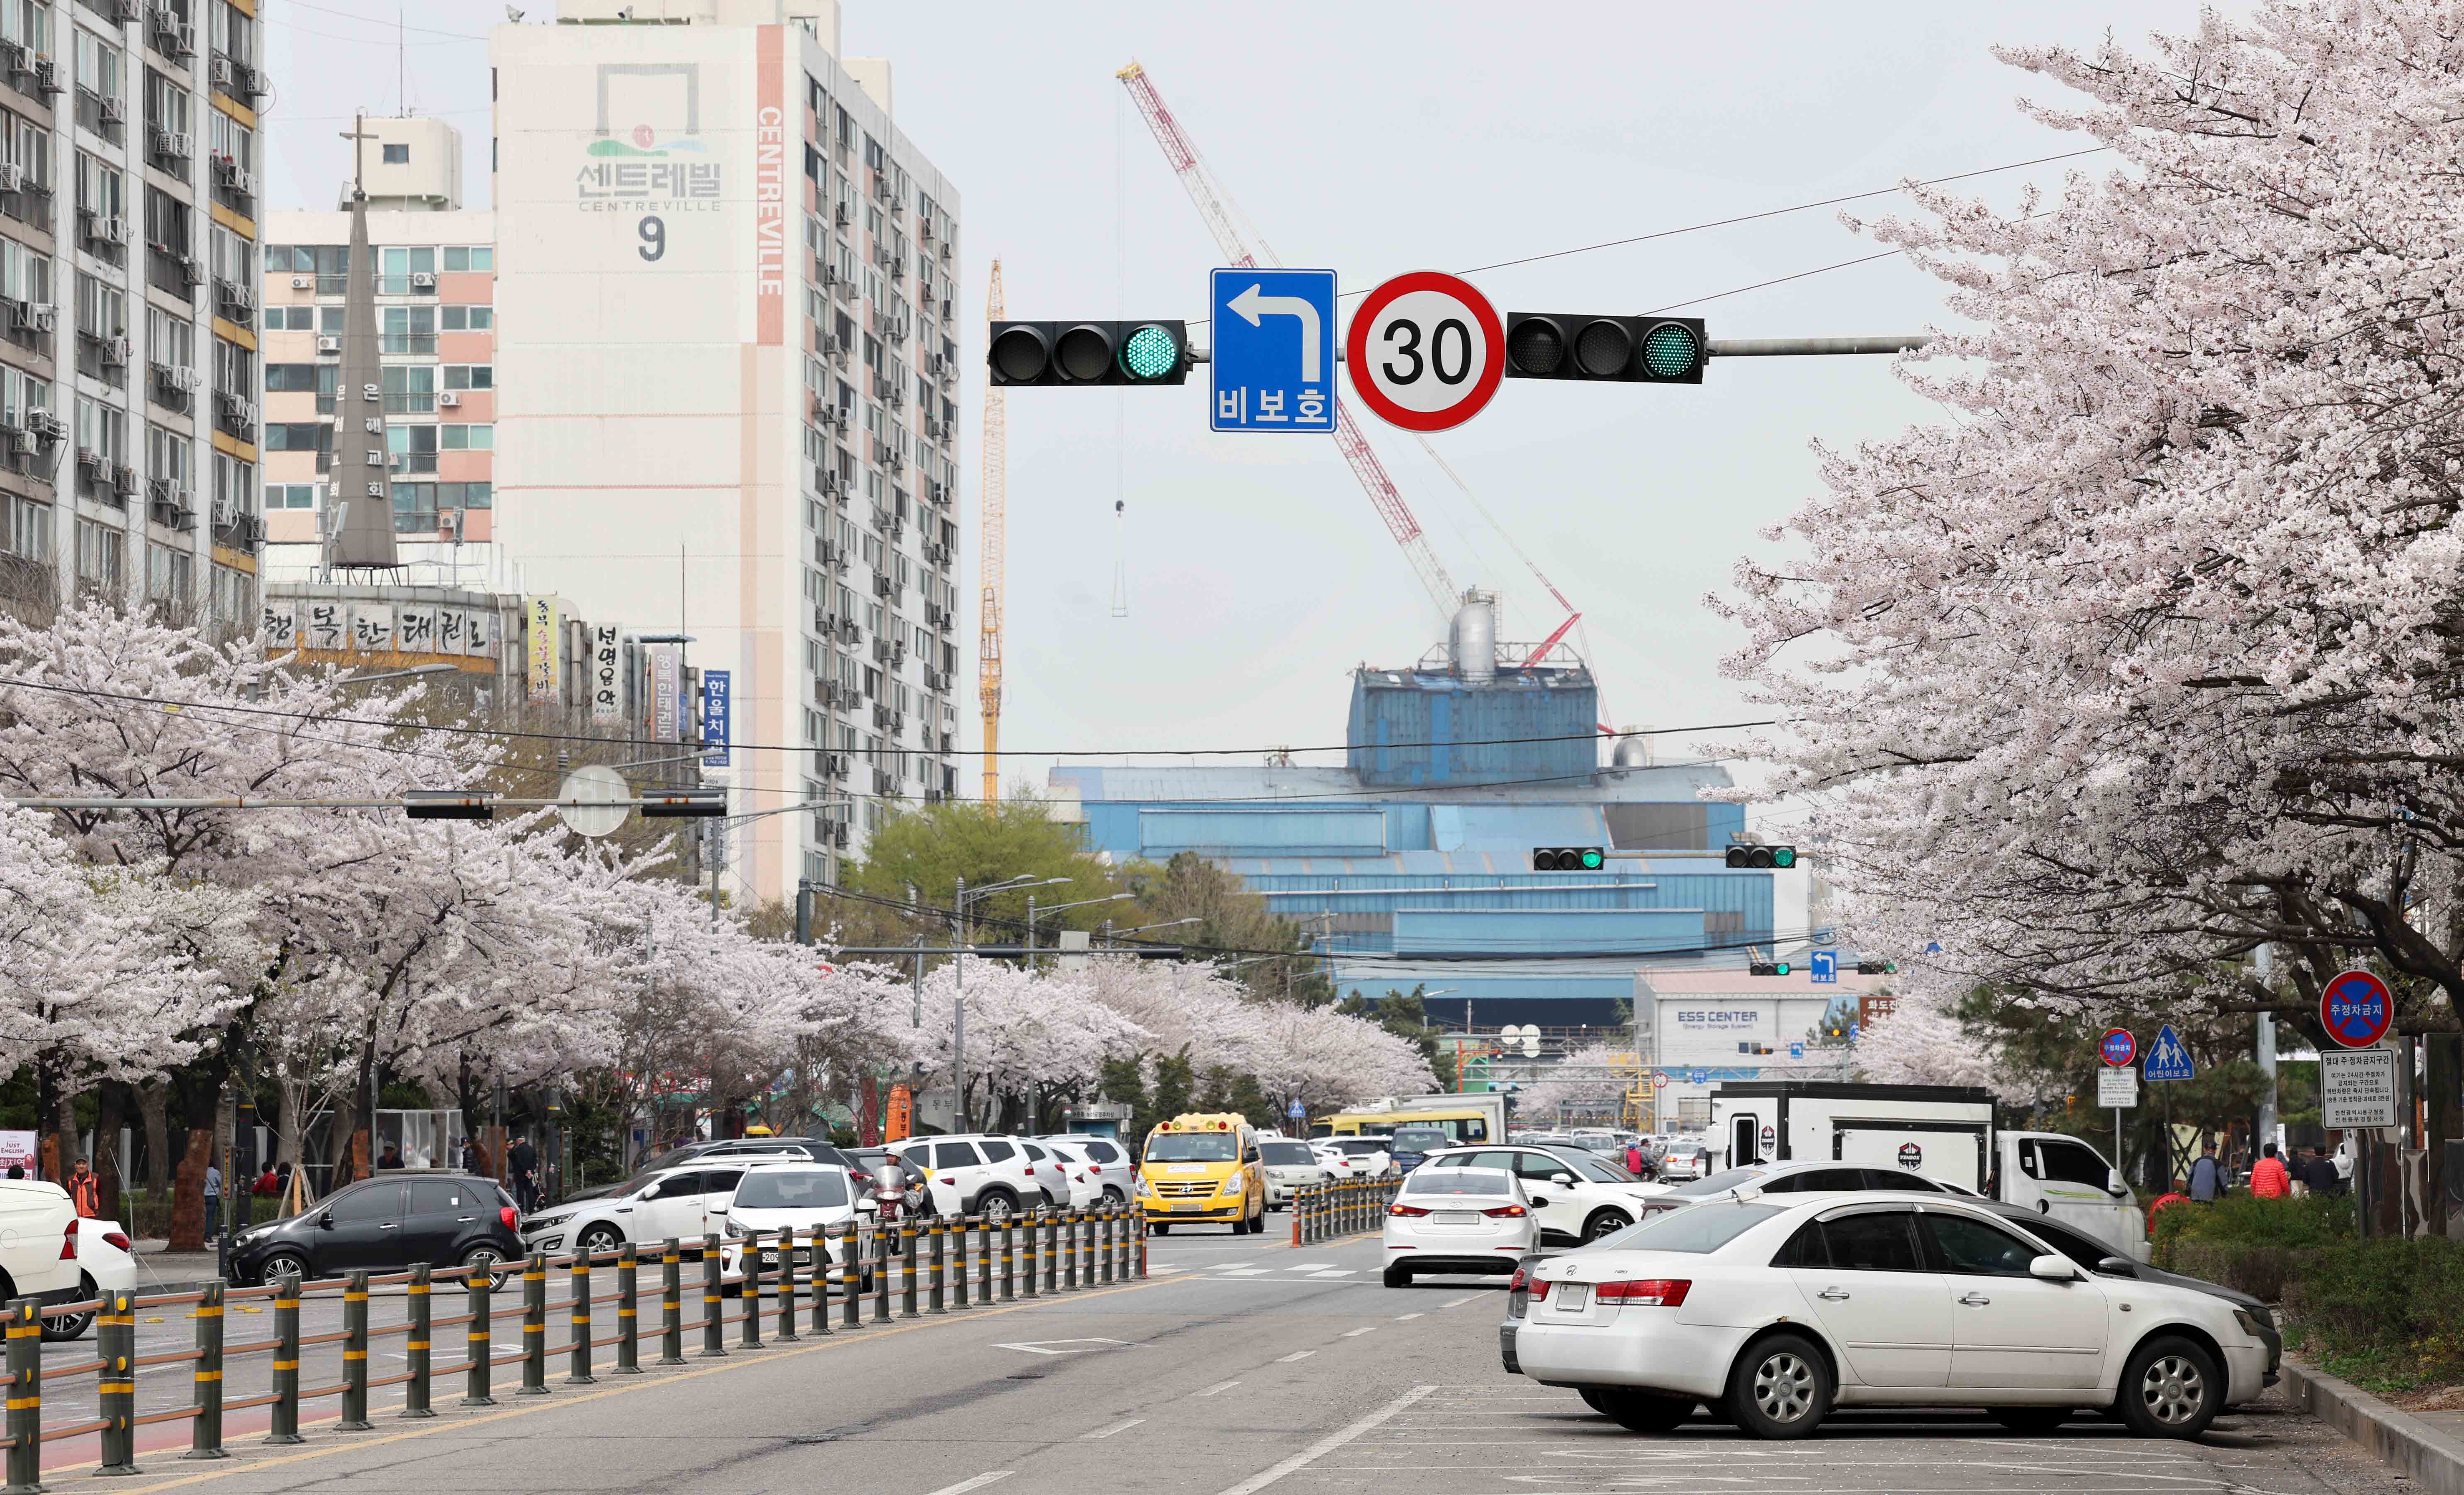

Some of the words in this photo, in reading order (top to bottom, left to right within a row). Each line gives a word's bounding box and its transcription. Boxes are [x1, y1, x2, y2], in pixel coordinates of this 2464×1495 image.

[576, 163, 721, 198] 센트레빌
[579, 202, 721, 212] CENTREVILLE
[758, 106, 782, 296] CENTREVILLE
[638, 215, 665, 262] 9
[1382, 318, 1472, 385] 30
[1219, 386, 1328, 424] 비보호
[363, 383, 384, 499] 은혜교회
[707, 680, 726, 753] 한울치과
[1812, 973, 1836, 982] 비보호
[1678, 1011, 1705, 1022] ESS
[1708, 1011, 1758, 1022] CENTER
[2330, 1003, 2382, 1016] 주정차금지
[2148, 1069, 2191, 1078] 어린이보호
[2325, 1057, 2339, 1066] 절대
